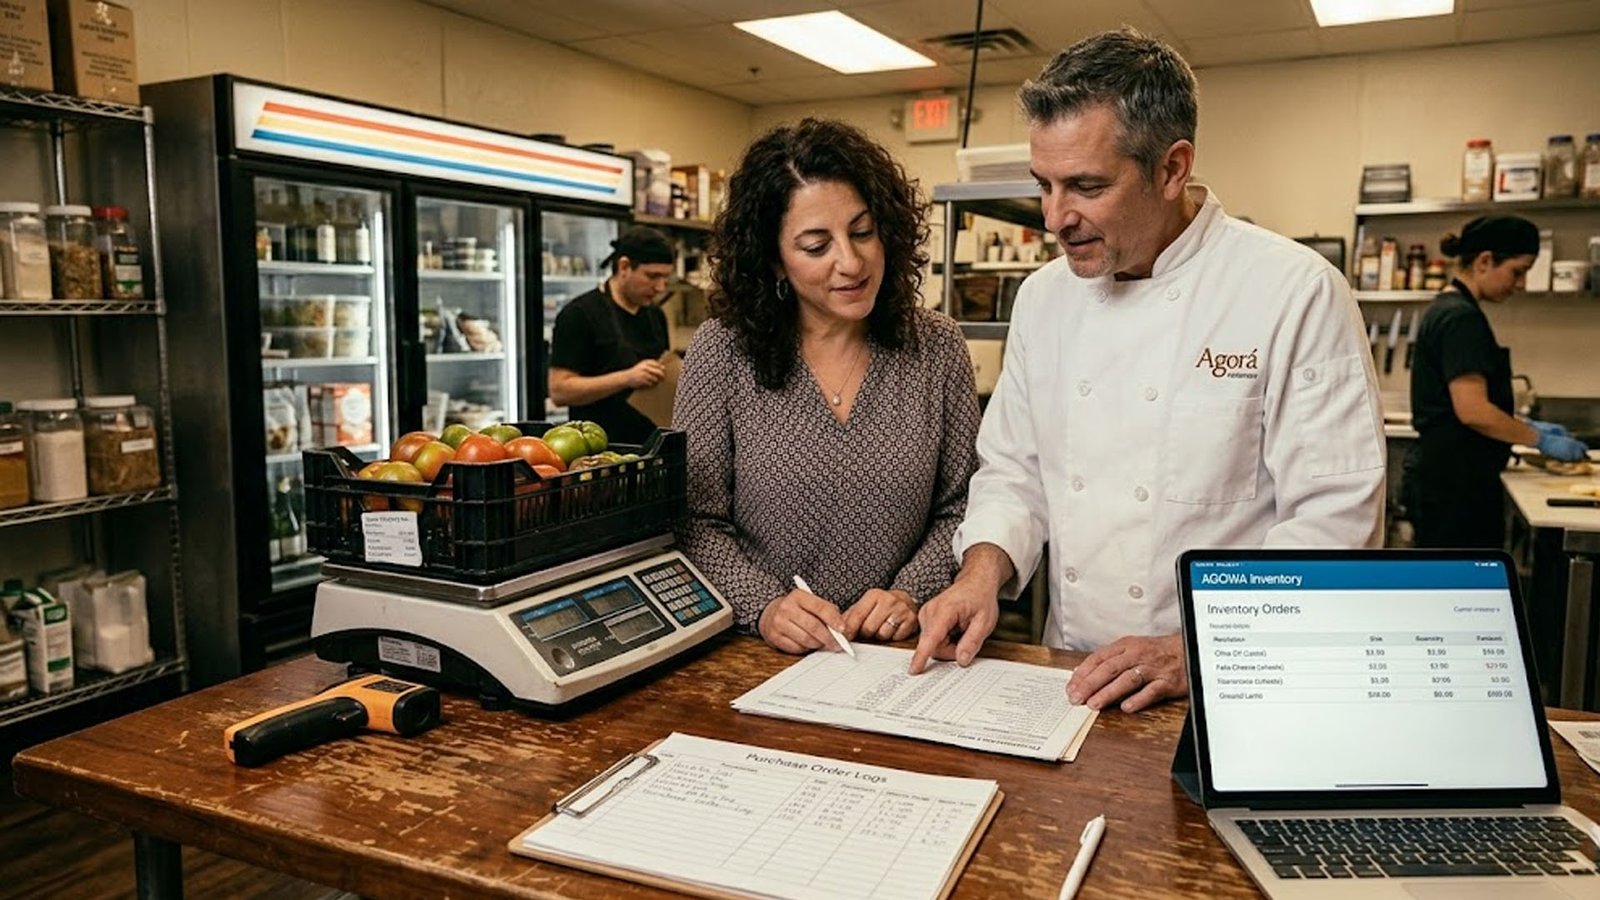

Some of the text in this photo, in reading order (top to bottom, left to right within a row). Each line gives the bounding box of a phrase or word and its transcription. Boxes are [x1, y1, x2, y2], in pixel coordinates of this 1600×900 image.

[1195, 347, 1258, 378] Agorá
[1201, 573, 1248, 585] AGOWA
[1207, 603, 1301, 617] Inventory Orders
[746, 752, 808, 770] Purchase
[811, 764, 852, 778] Order
